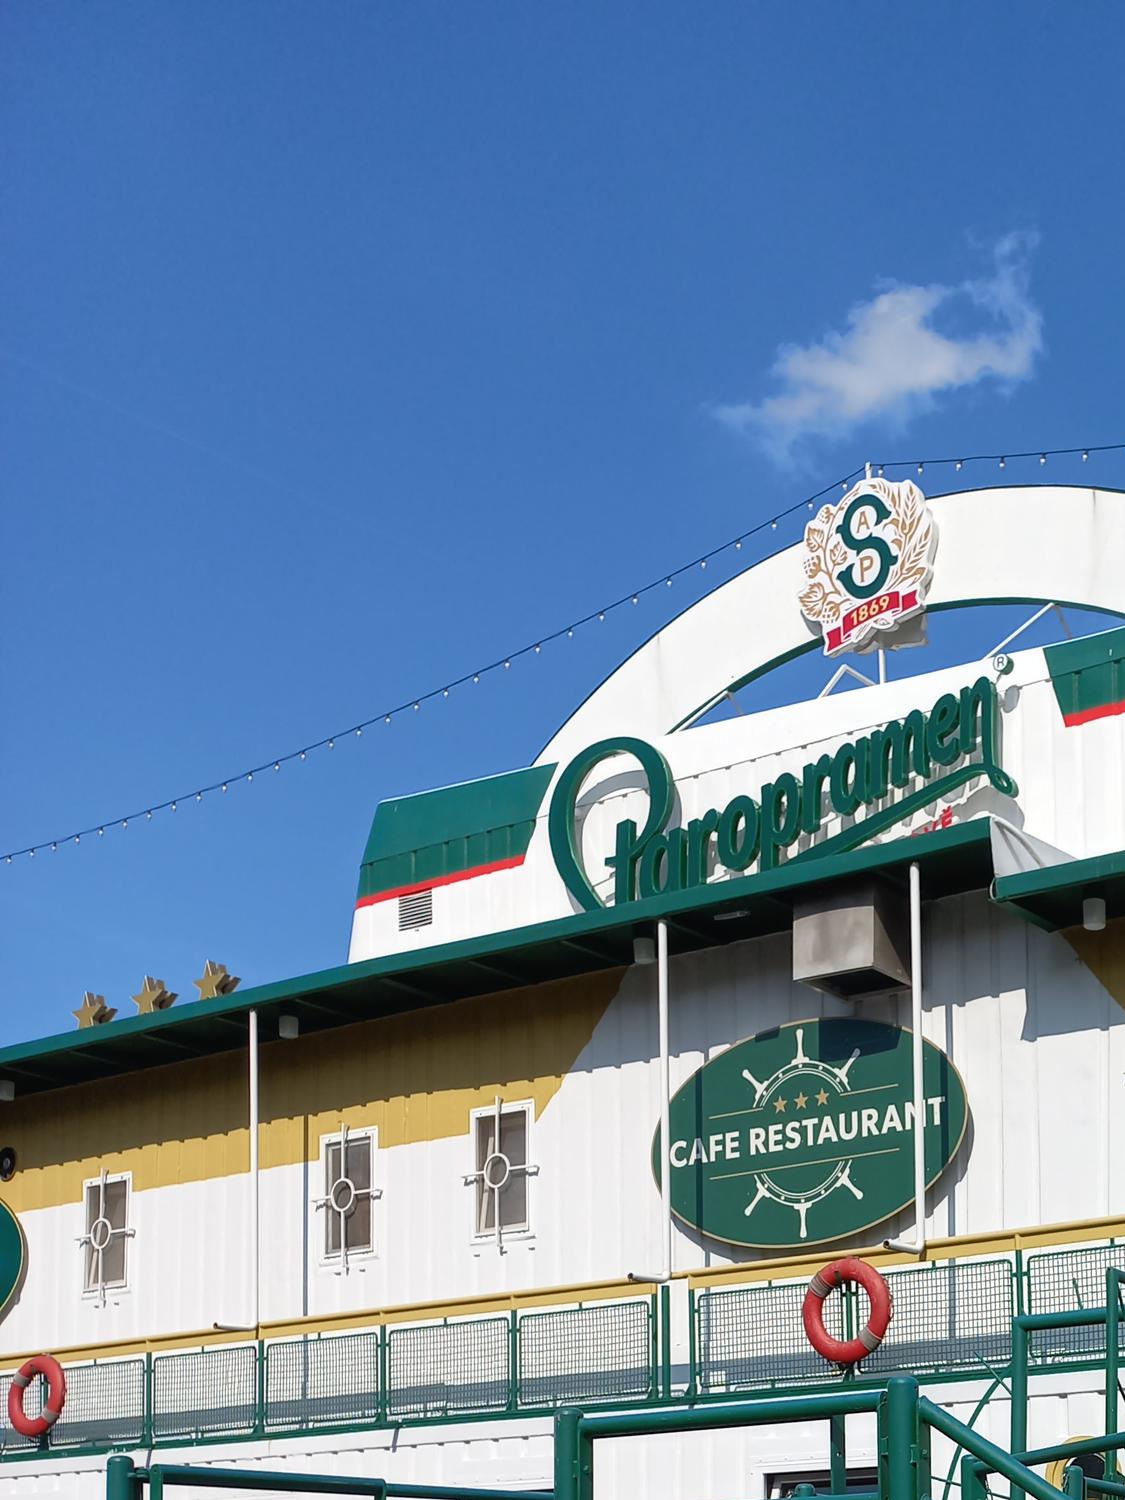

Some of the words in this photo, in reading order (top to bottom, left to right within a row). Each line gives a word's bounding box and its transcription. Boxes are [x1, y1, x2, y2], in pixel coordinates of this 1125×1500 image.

[856, 511, 870, 533] A
[859, 555, 874, 583] P
[851, 596, 889, 625] 1869
[669, 1131, 741, 1168] CAFE
[750, 1096, 945, 1156] RESTAURANT
